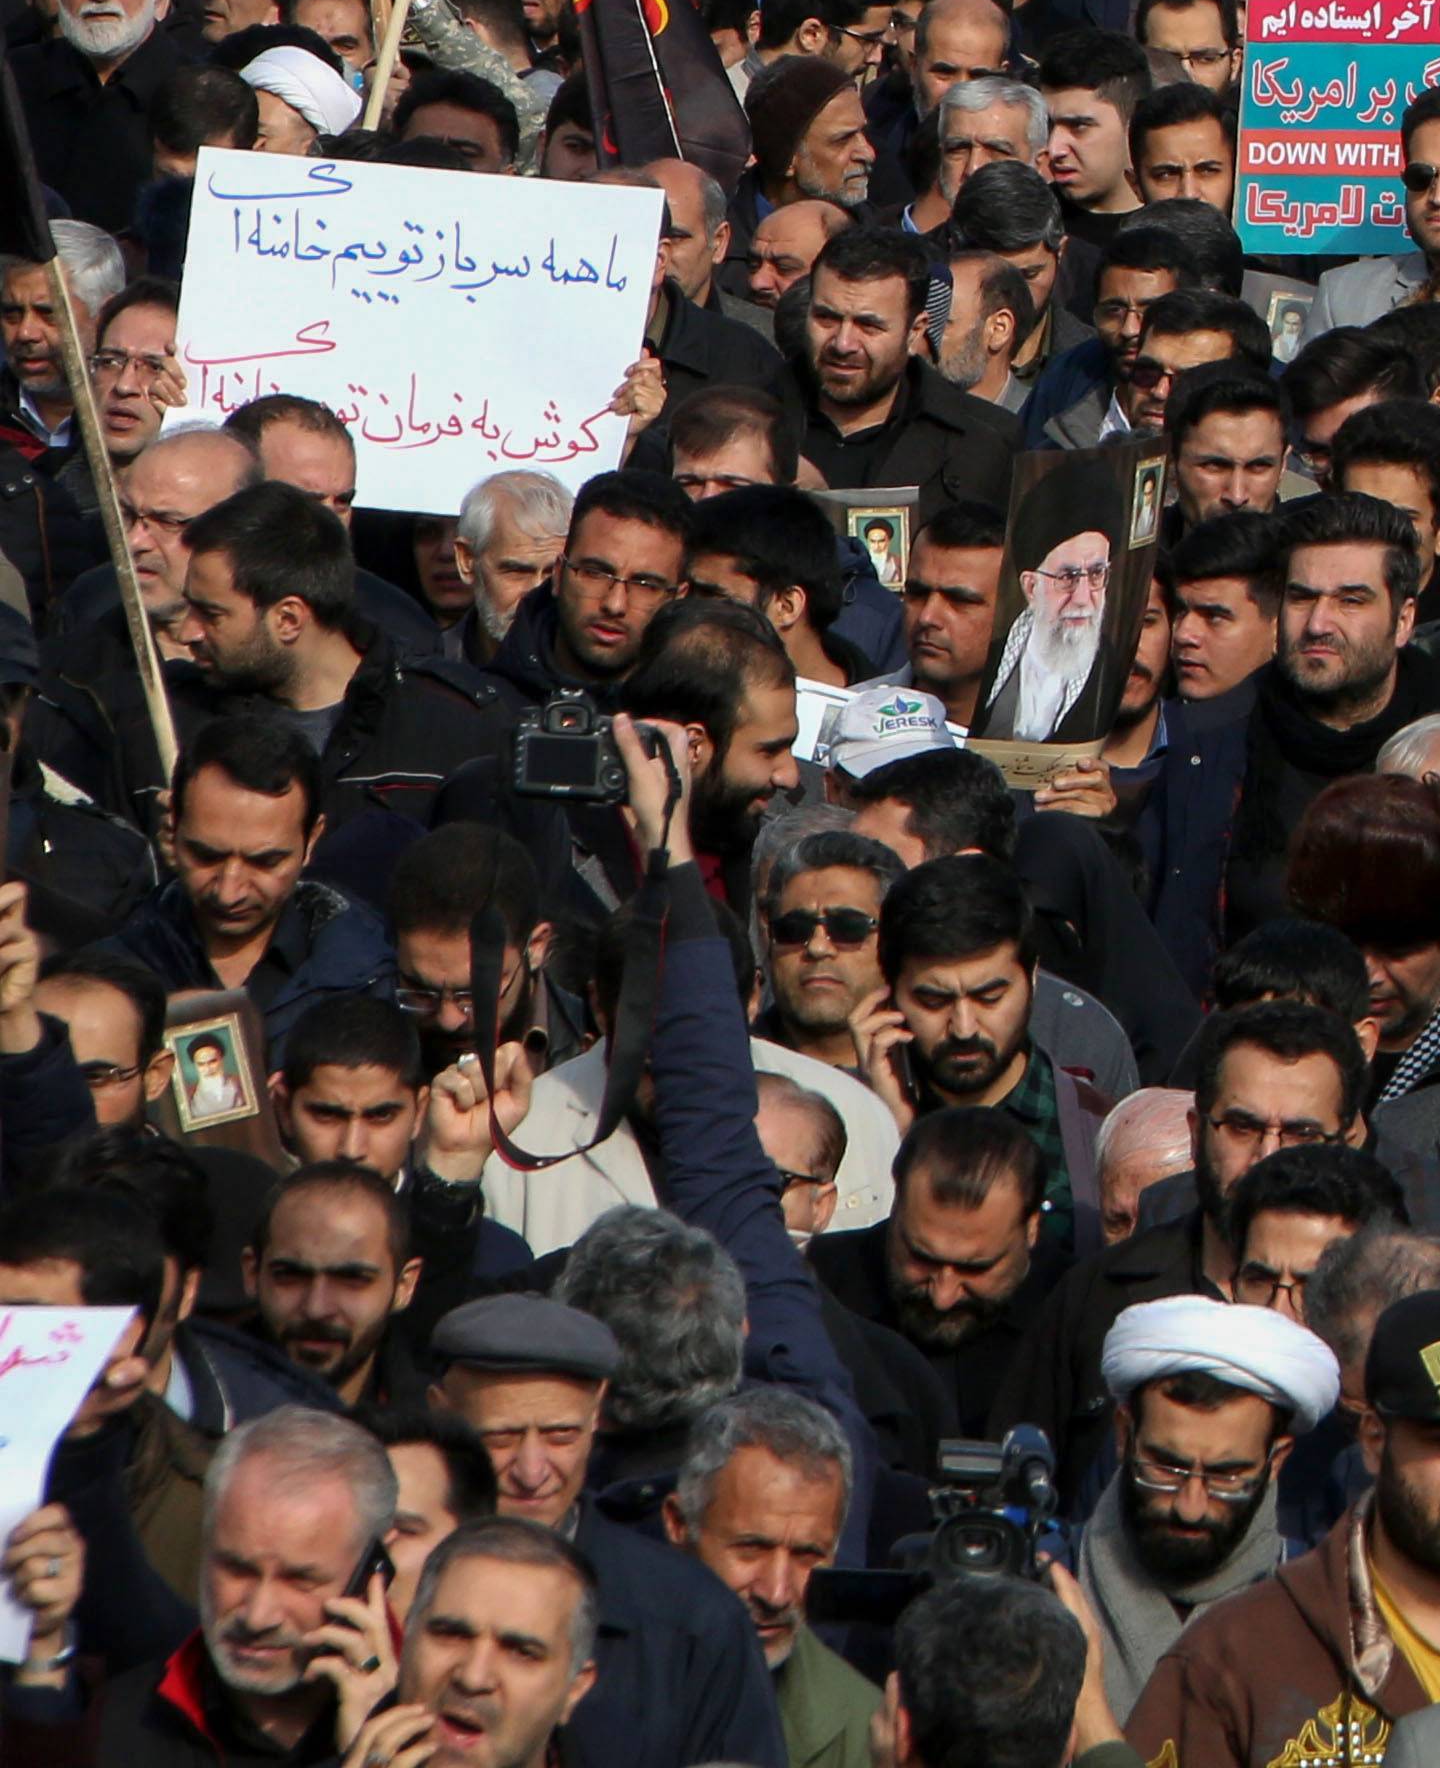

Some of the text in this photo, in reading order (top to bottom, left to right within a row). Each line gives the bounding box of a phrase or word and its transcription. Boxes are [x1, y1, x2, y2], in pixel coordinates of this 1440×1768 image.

[414, 221, 530, 304] سرباز
[541, 238, 600, 283] همه
[605, 234, 628, 291] ما
[362, 373, 463, 449] فرمان
[471, 400, 500, 462] به
